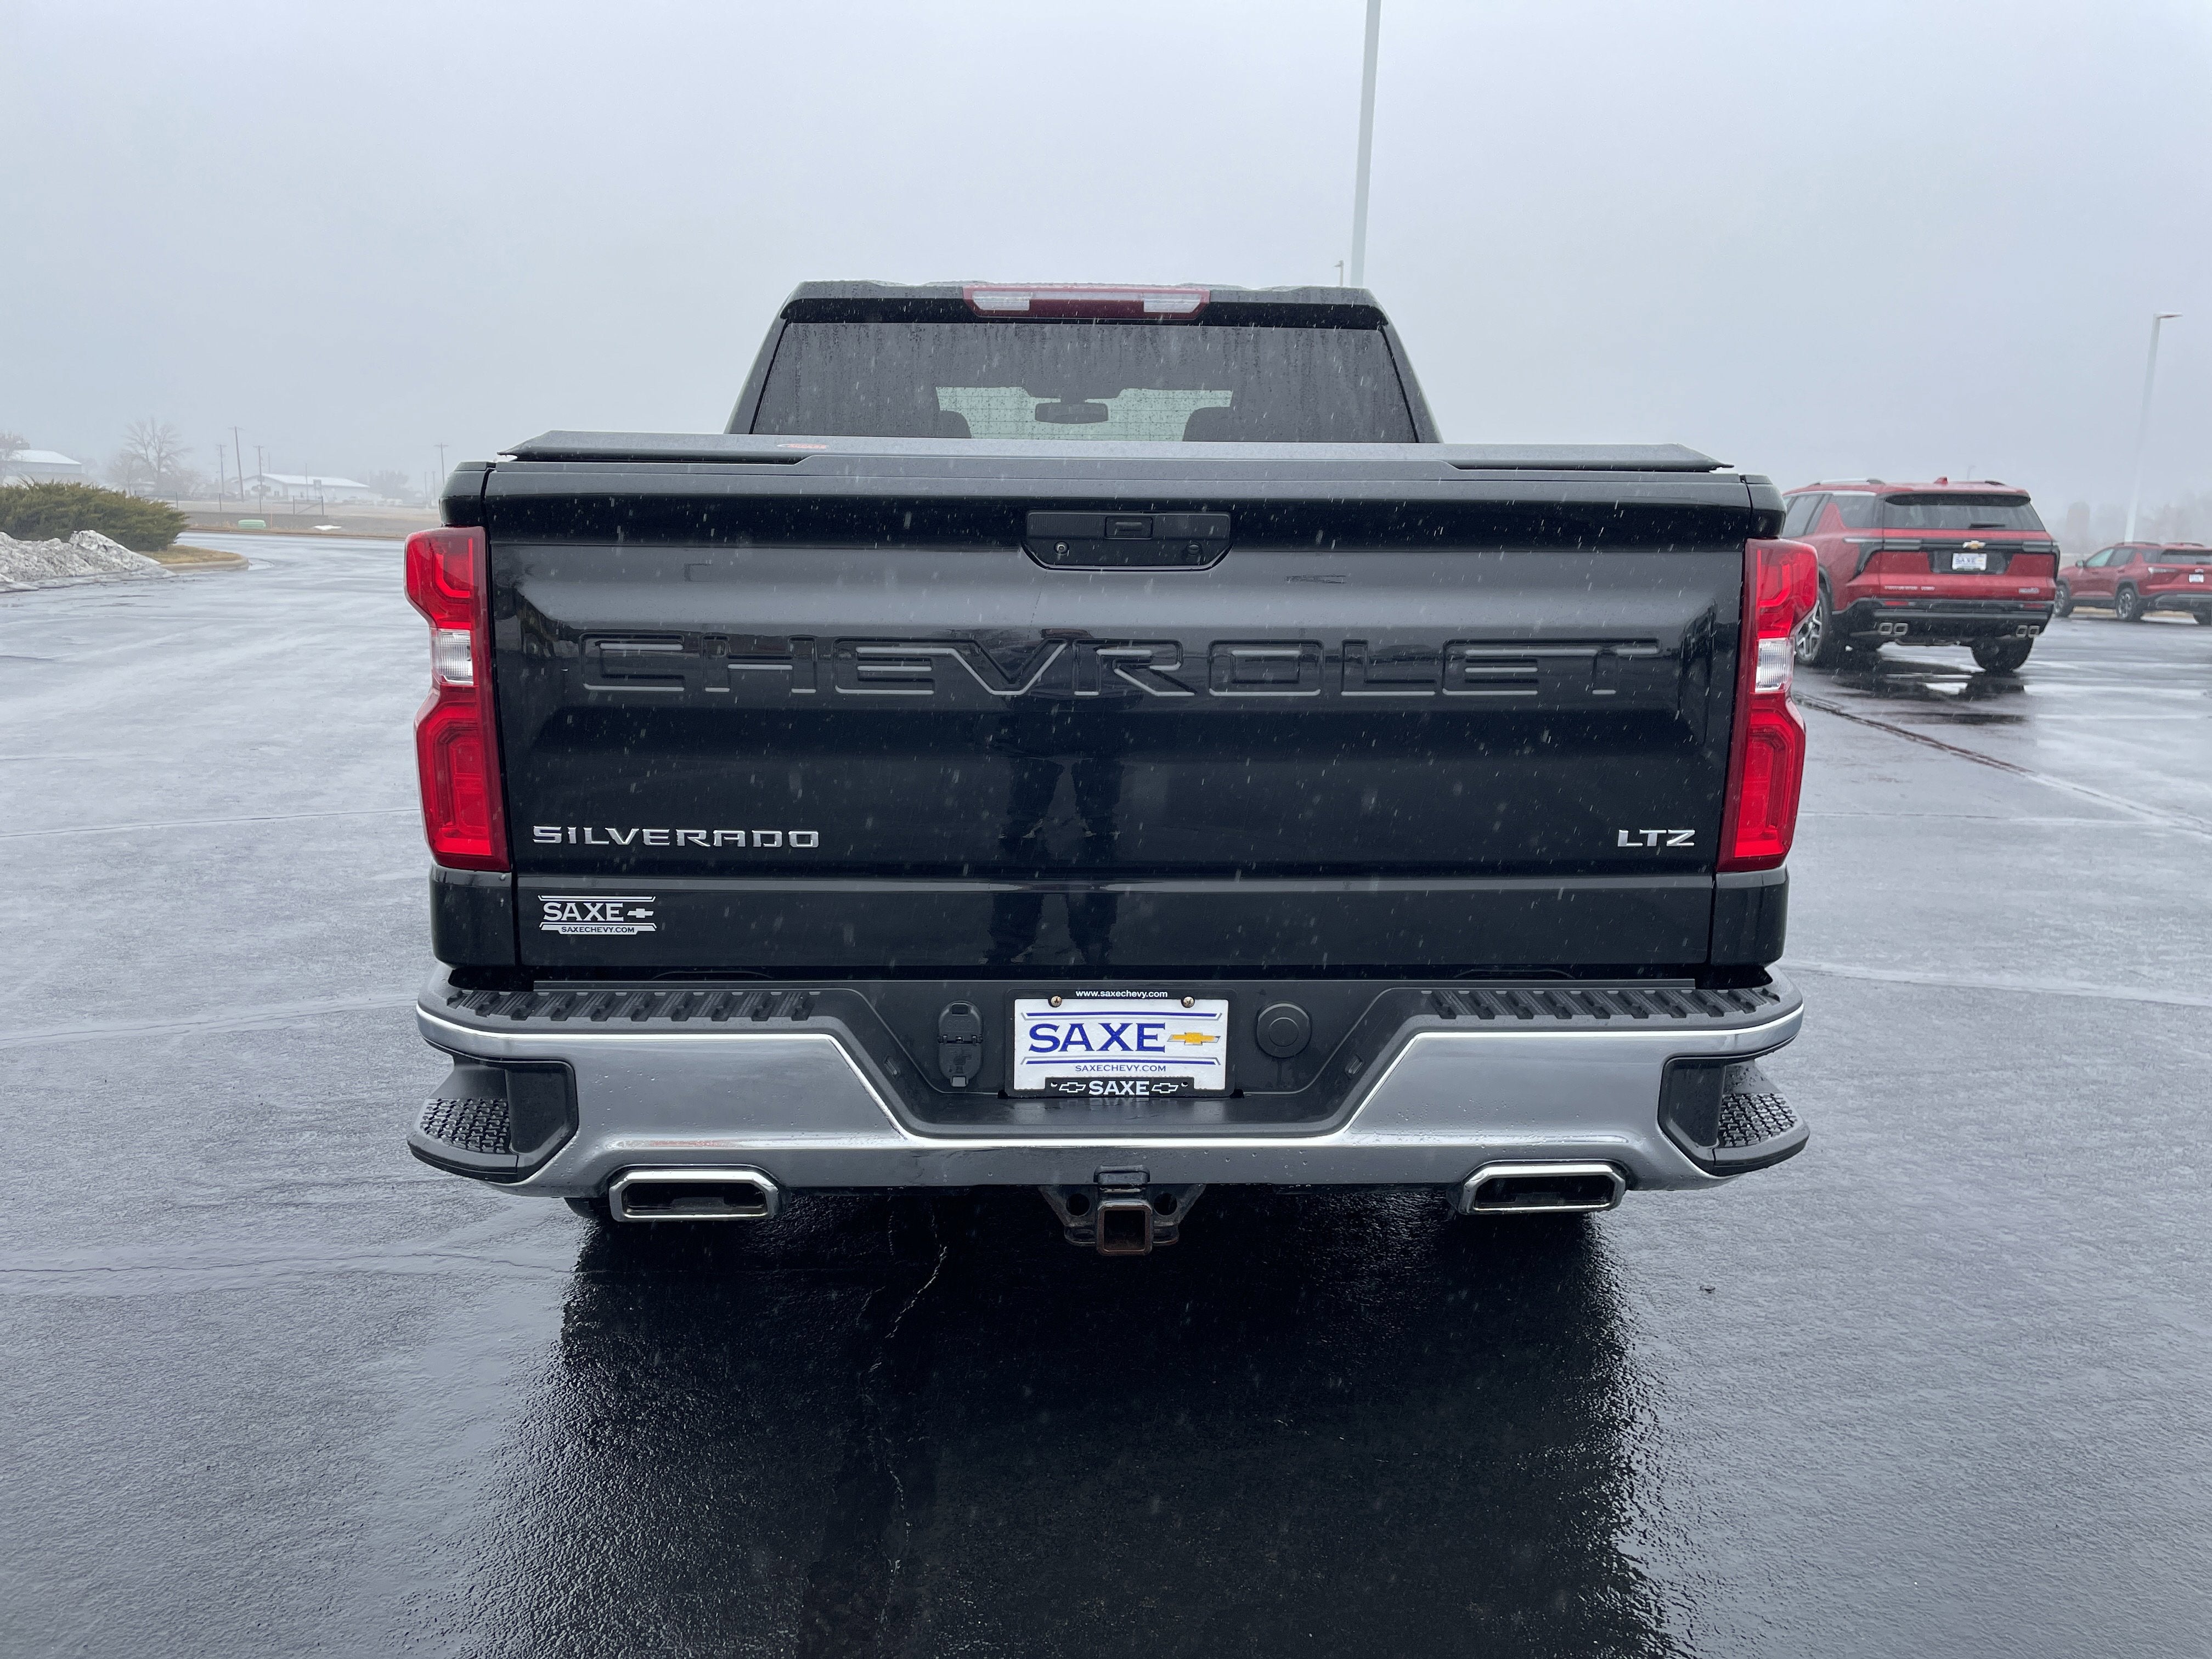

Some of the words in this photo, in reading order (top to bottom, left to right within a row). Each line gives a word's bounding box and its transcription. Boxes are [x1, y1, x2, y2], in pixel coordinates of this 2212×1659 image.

[579, 632, 1660, 697] CHEVROLET
[532, 825, 819, 848] SILVERADO
[1617, 829, 1695, 847] LTZ
[543, 902, 624, 921] SAXE
[1075, 990, 1168, 998] www.saxechevy.com
[1029, 1023, 1165, 1053] SAXE
[1088, 1080, 1149, 1096] SAXE
